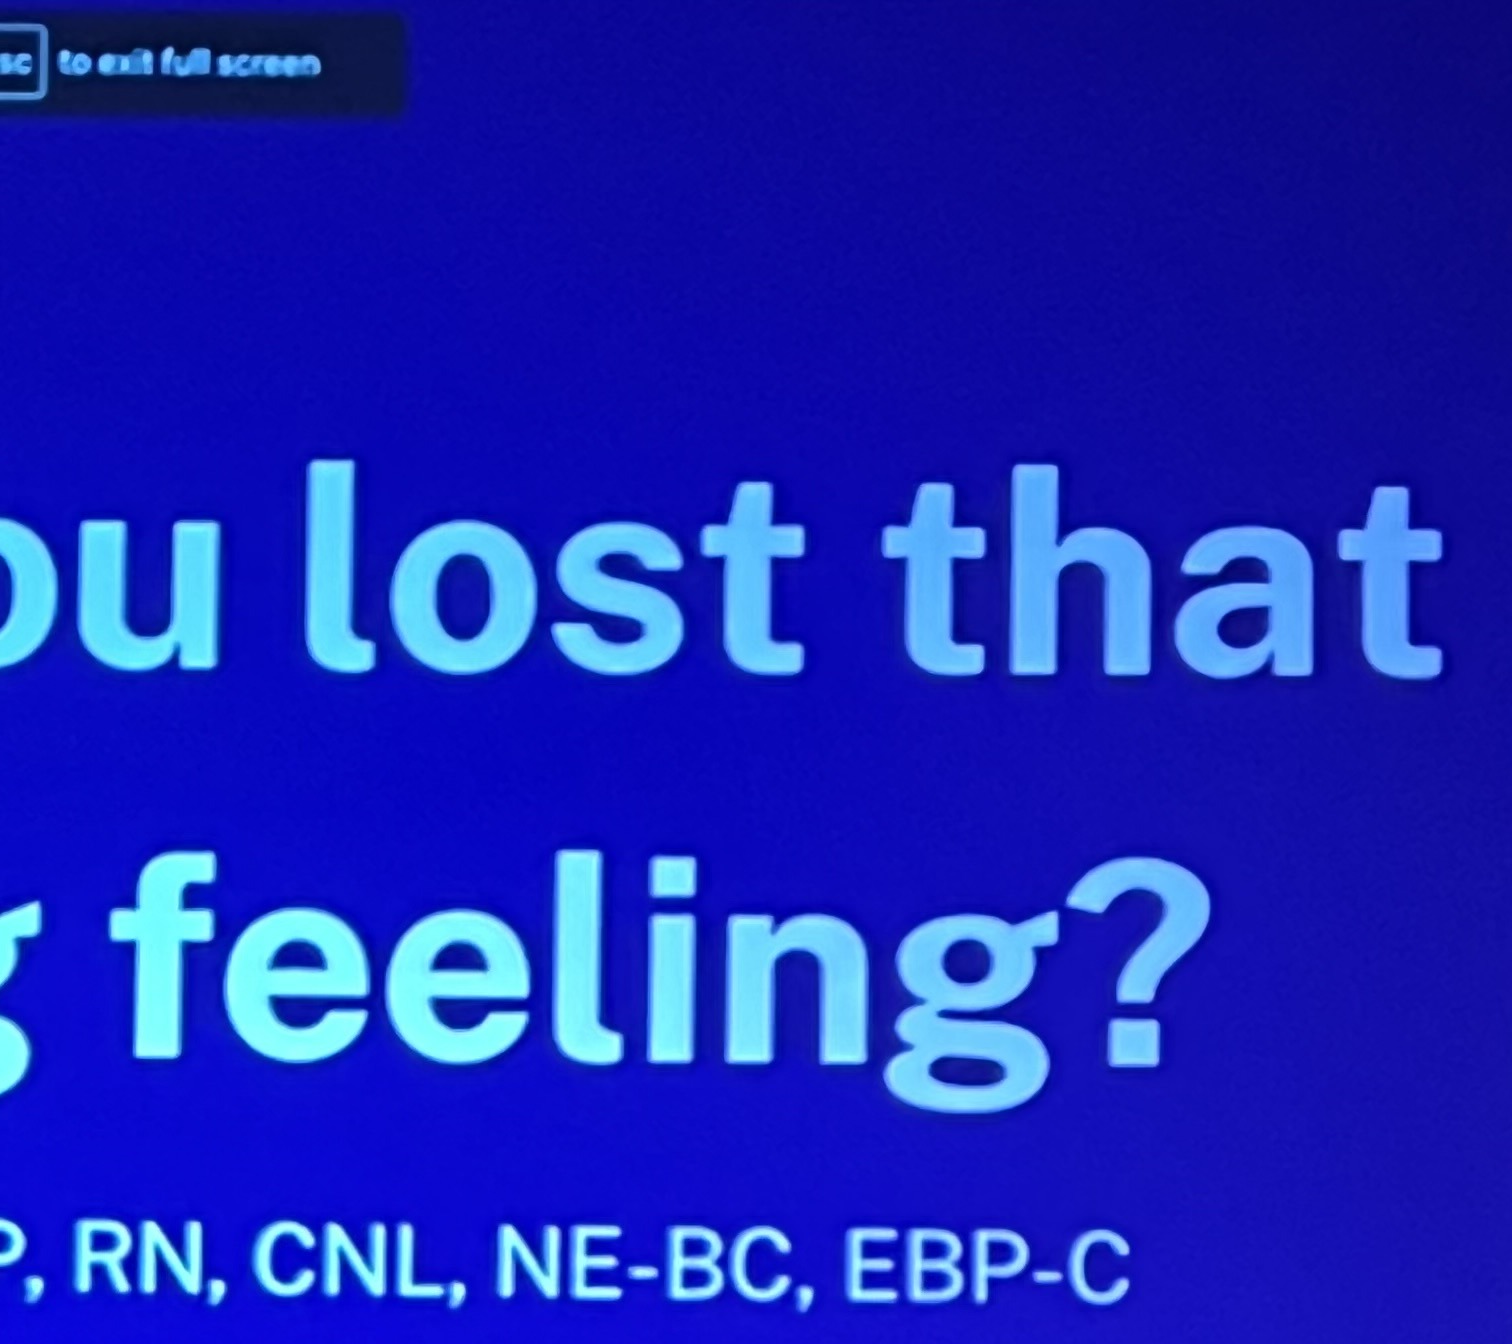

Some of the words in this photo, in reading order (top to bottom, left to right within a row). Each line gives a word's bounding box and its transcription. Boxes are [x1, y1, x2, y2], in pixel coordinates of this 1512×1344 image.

[57, 48, 93, 76] to
[97, 47, 154, 76] exit
[160, 45, 212, 78] full
[215, 53, 322, 78] screen
[305, 458, 806, 677] lost
[882, 463, 1443, 680] that
[107, 848, 1212, 1115] feeling?
[73, 1217, 228, 1306] RN,
[252, 1219, 467, 1309] CNL,
[496, 1223, 815, 1313] NE-BC,
[845, 1227, 1130, 1306] EBP-C
